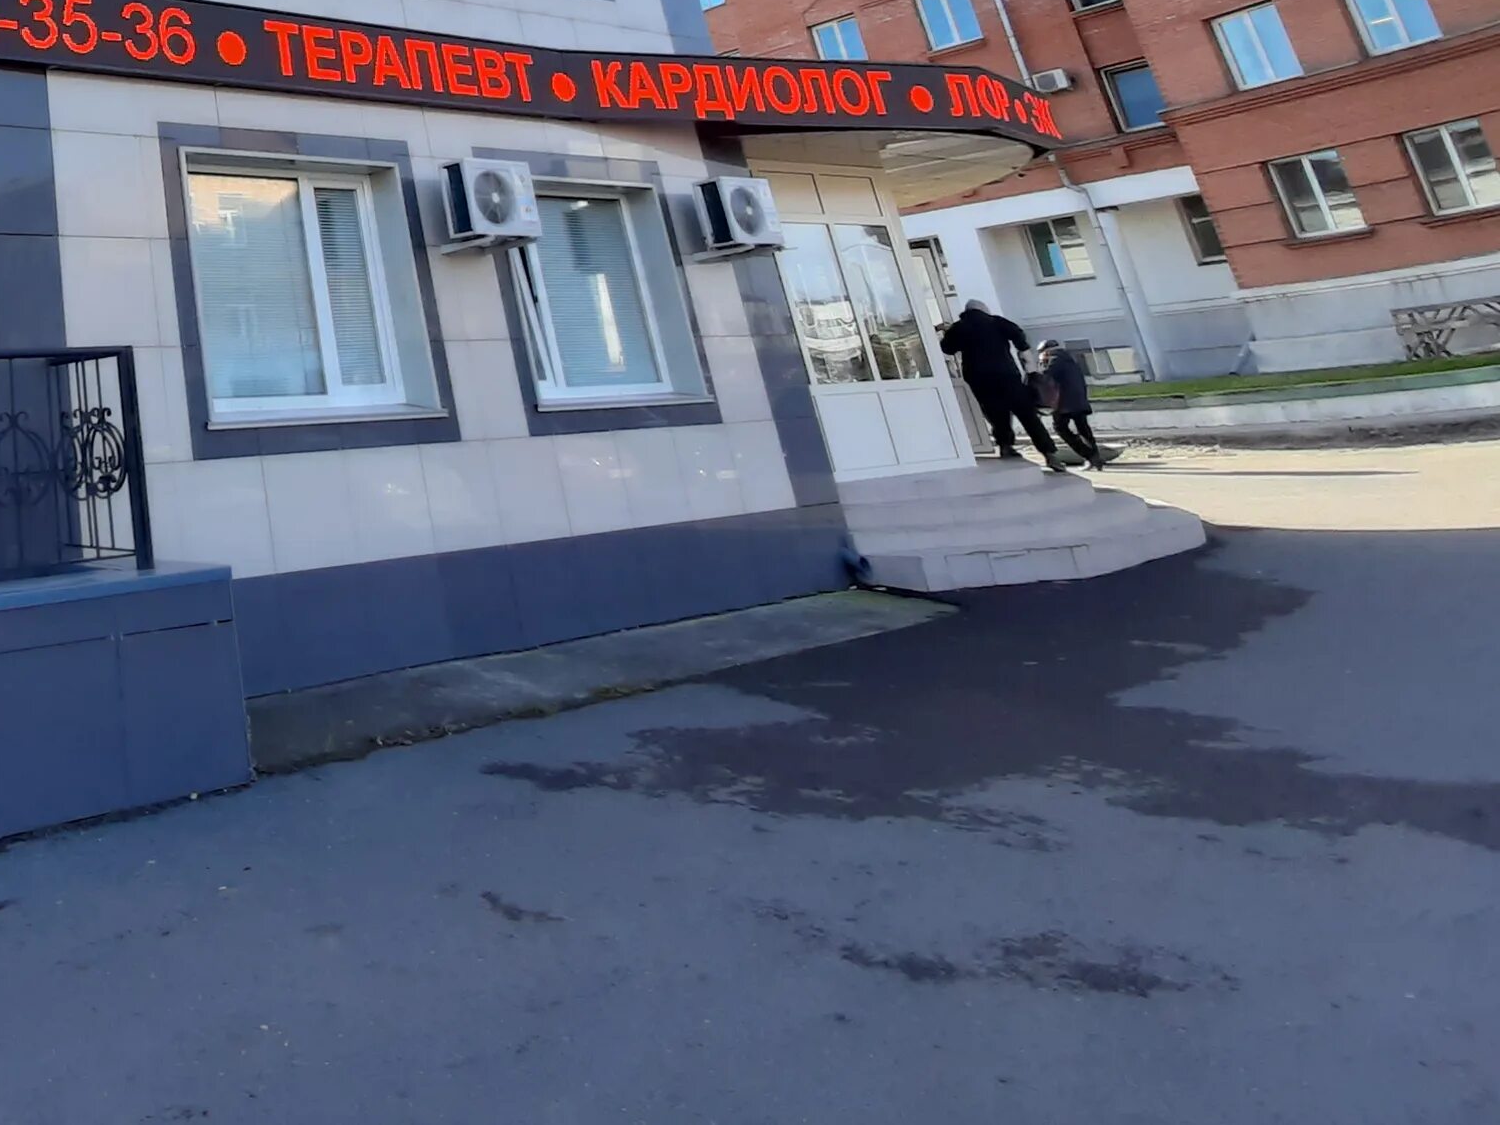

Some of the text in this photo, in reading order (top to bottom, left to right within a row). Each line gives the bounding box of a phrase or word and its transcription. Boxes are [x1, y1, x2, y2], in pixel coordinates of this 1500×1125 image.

[263, 19, 533, 103] ТЕРАПЕВТ
[590, 59, 894, 121] КАРДИОЛОГ
[944, 73, 1011, 122] ЛОР
